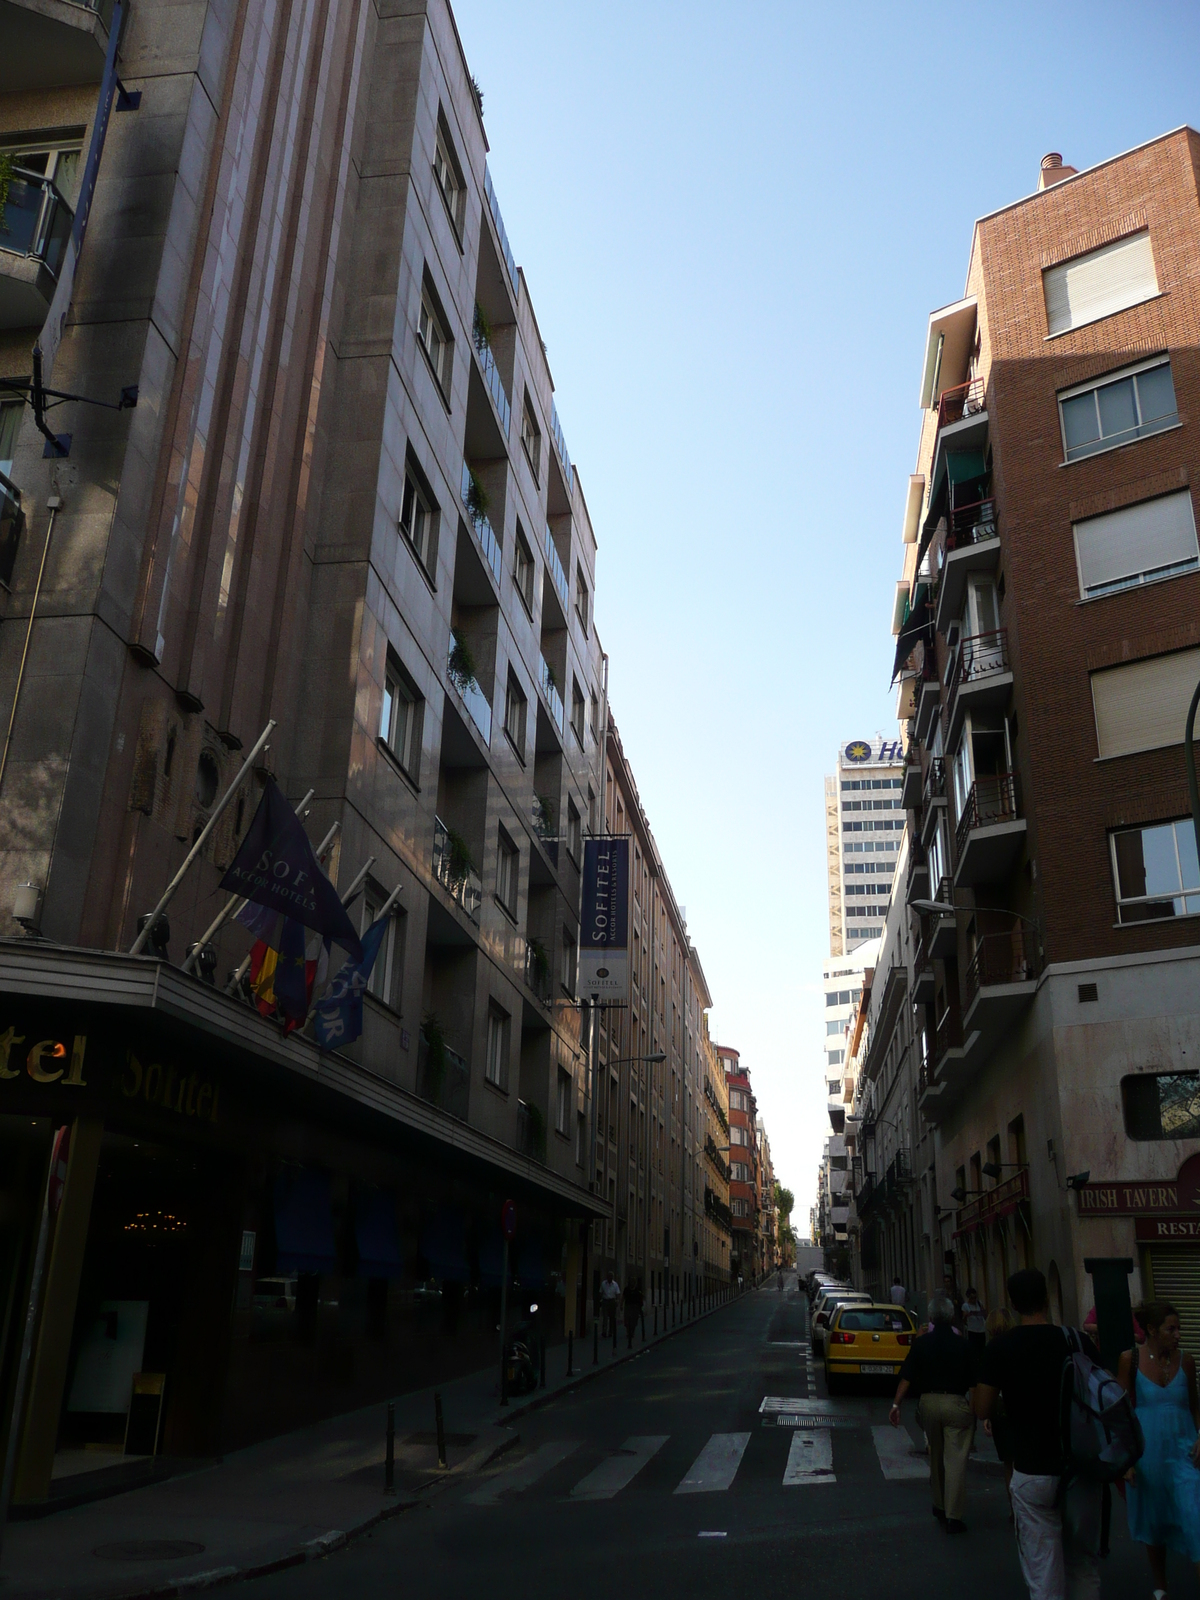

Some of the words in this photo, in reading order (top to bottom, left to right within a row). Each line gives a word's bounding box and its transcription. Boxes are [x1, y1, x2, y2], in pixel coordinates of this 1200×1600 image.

[232, 866, 269, 888] ACCOR
[271, 882, 317, 911] HOTELS
[591, 851, 610, 941] SOFITEL
[1080, 1189, 1118, 1209] IRISH
[1122, 1187, 1179, 1208] TAVERN
